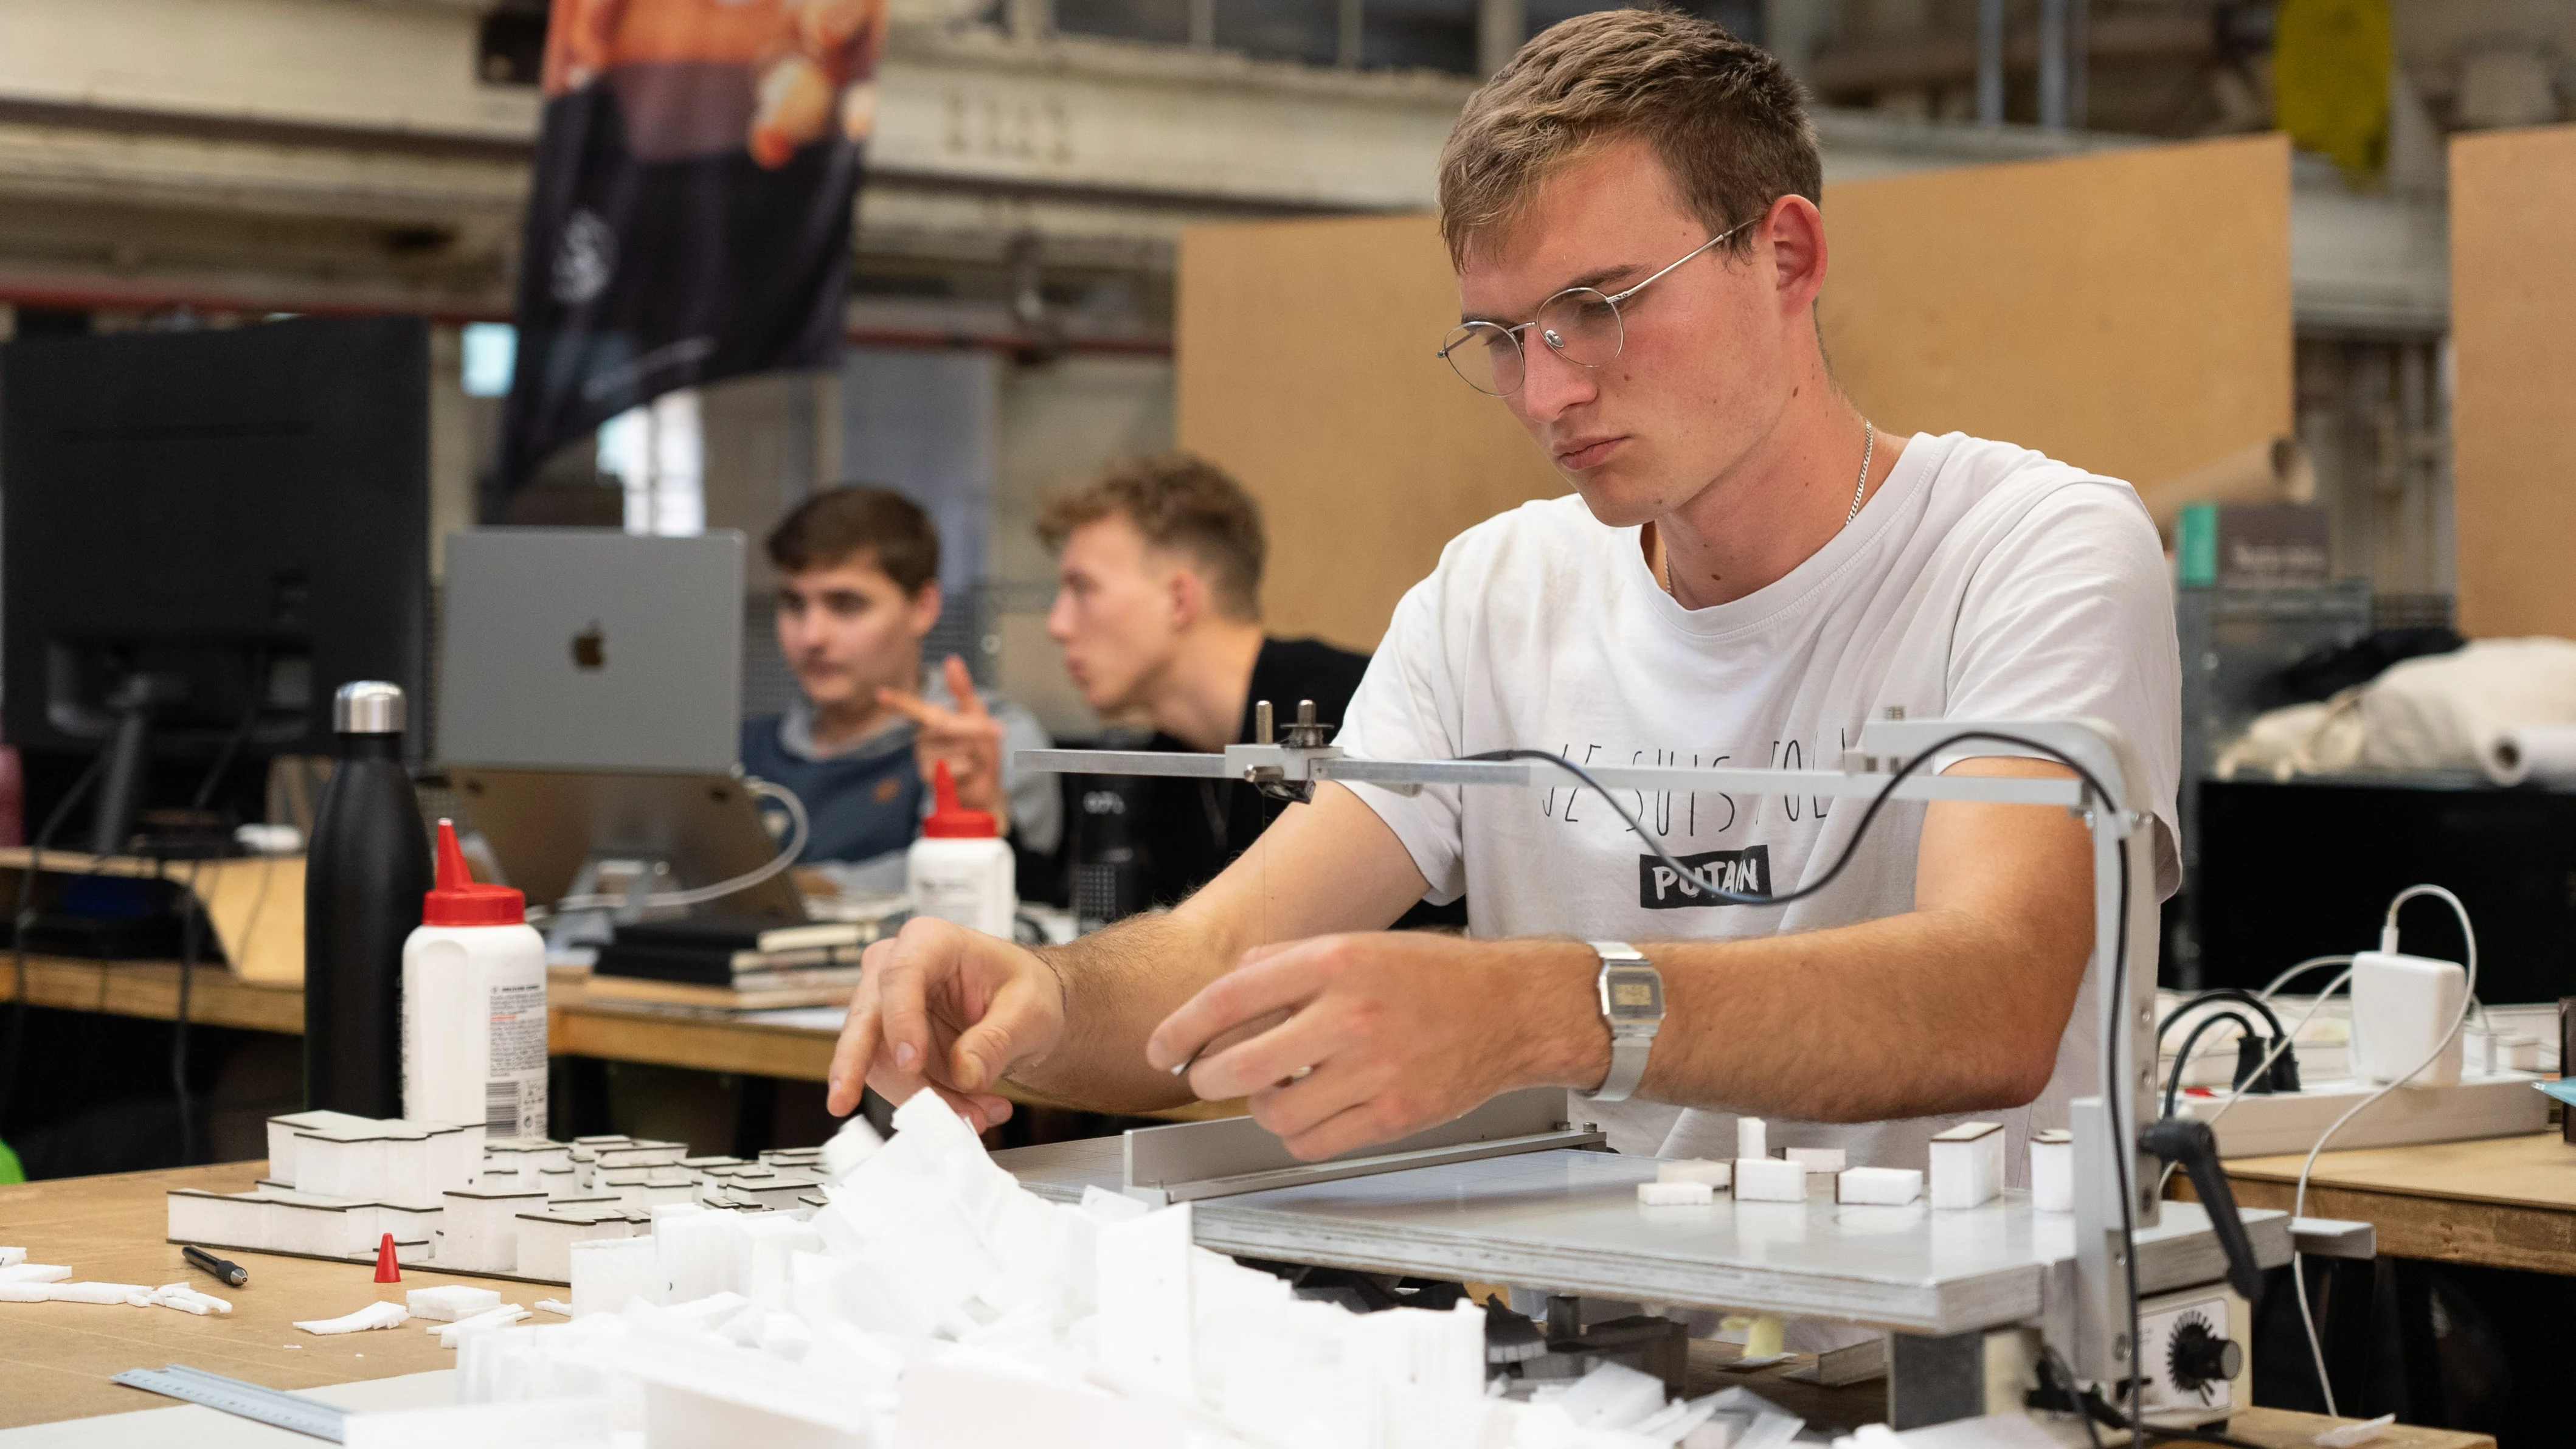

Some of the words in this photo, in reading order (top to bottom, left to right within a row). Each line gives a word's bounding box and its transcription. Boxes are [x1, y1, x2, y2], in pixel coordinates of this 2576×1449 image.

[1542, 743, 1602, 823] JE
[1625, 748, 1736, 837] SUIS
[1755, 727, 1846, 826] OL
